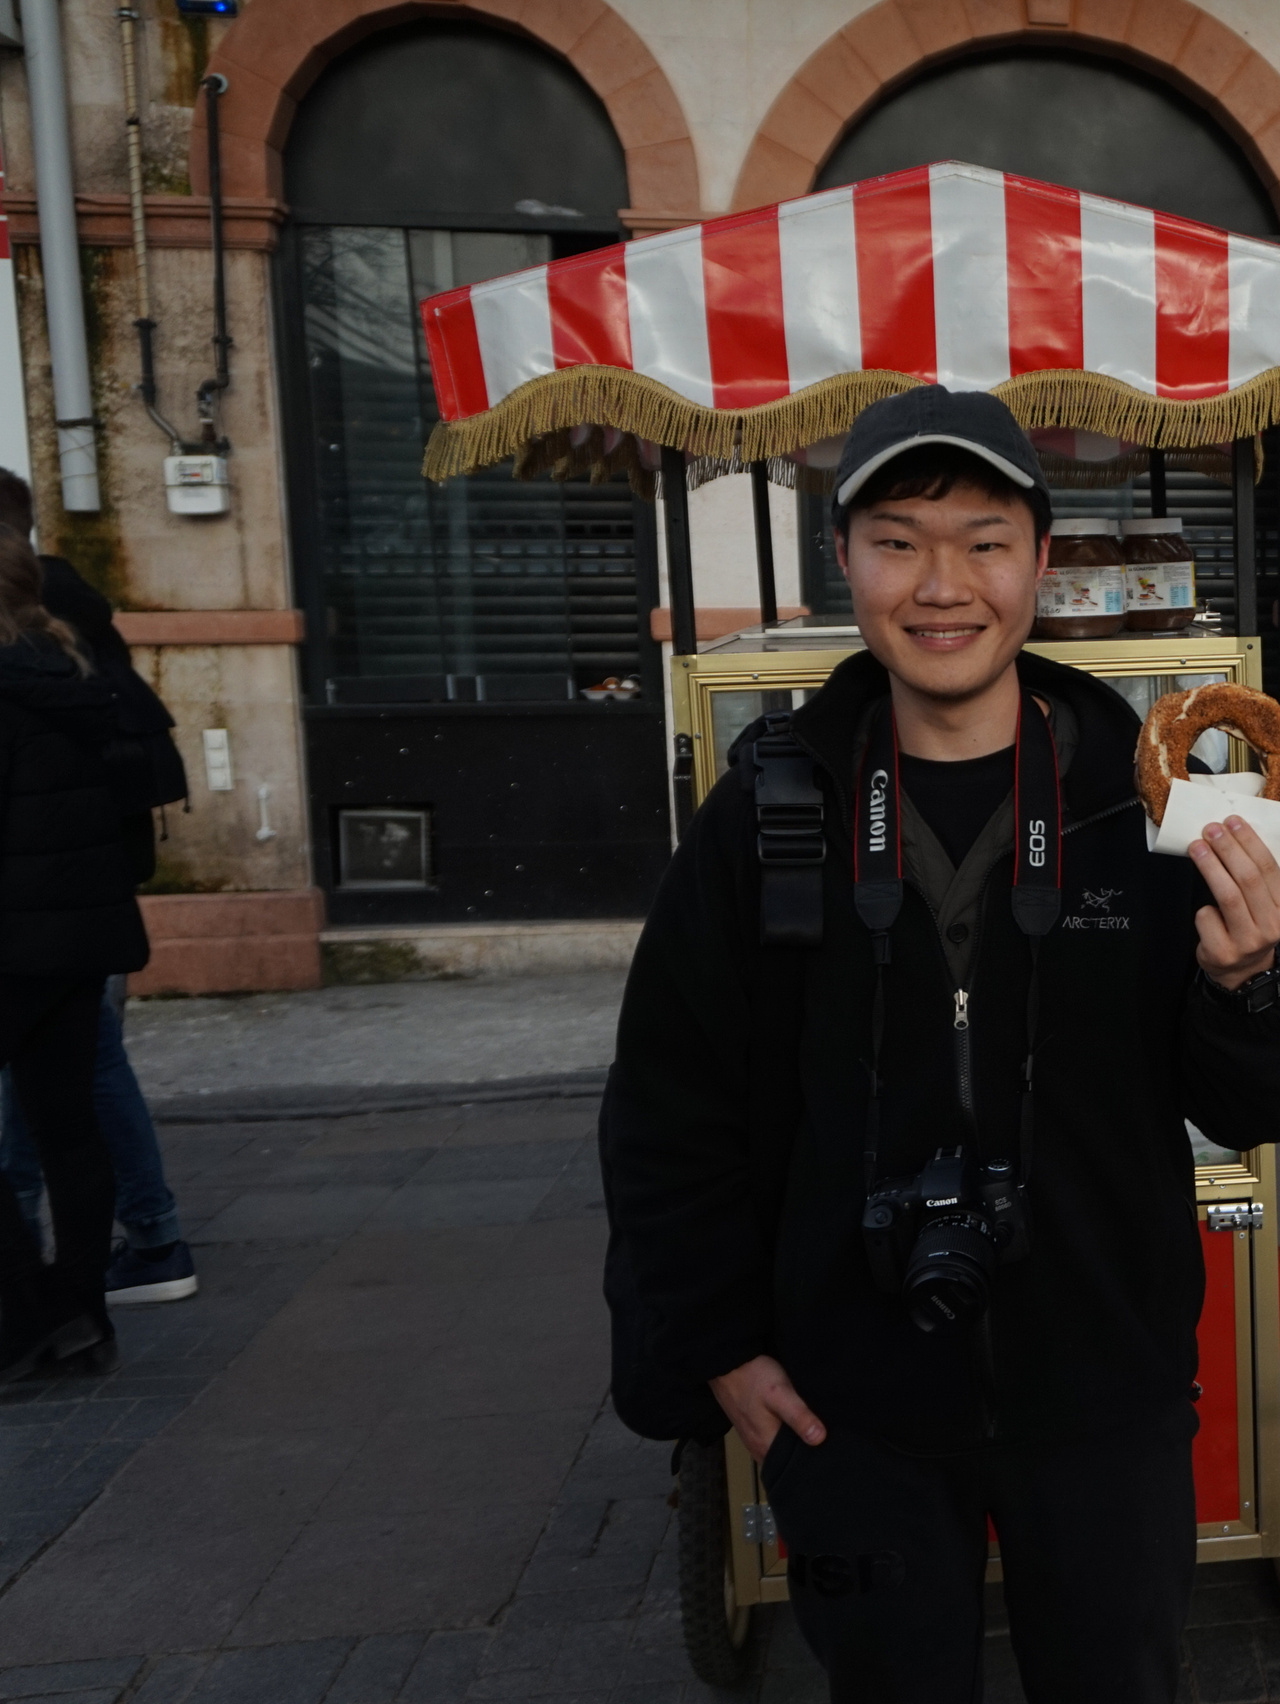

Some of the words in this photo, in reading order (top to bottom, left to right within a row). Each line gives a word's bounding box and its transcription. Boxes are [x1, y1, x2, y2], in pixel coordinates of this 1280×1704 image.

[869, 768, 889, 852] Canon
[1029, 819, 1046, 868] EOS
[926, 1197, 958, 1208] Canon
